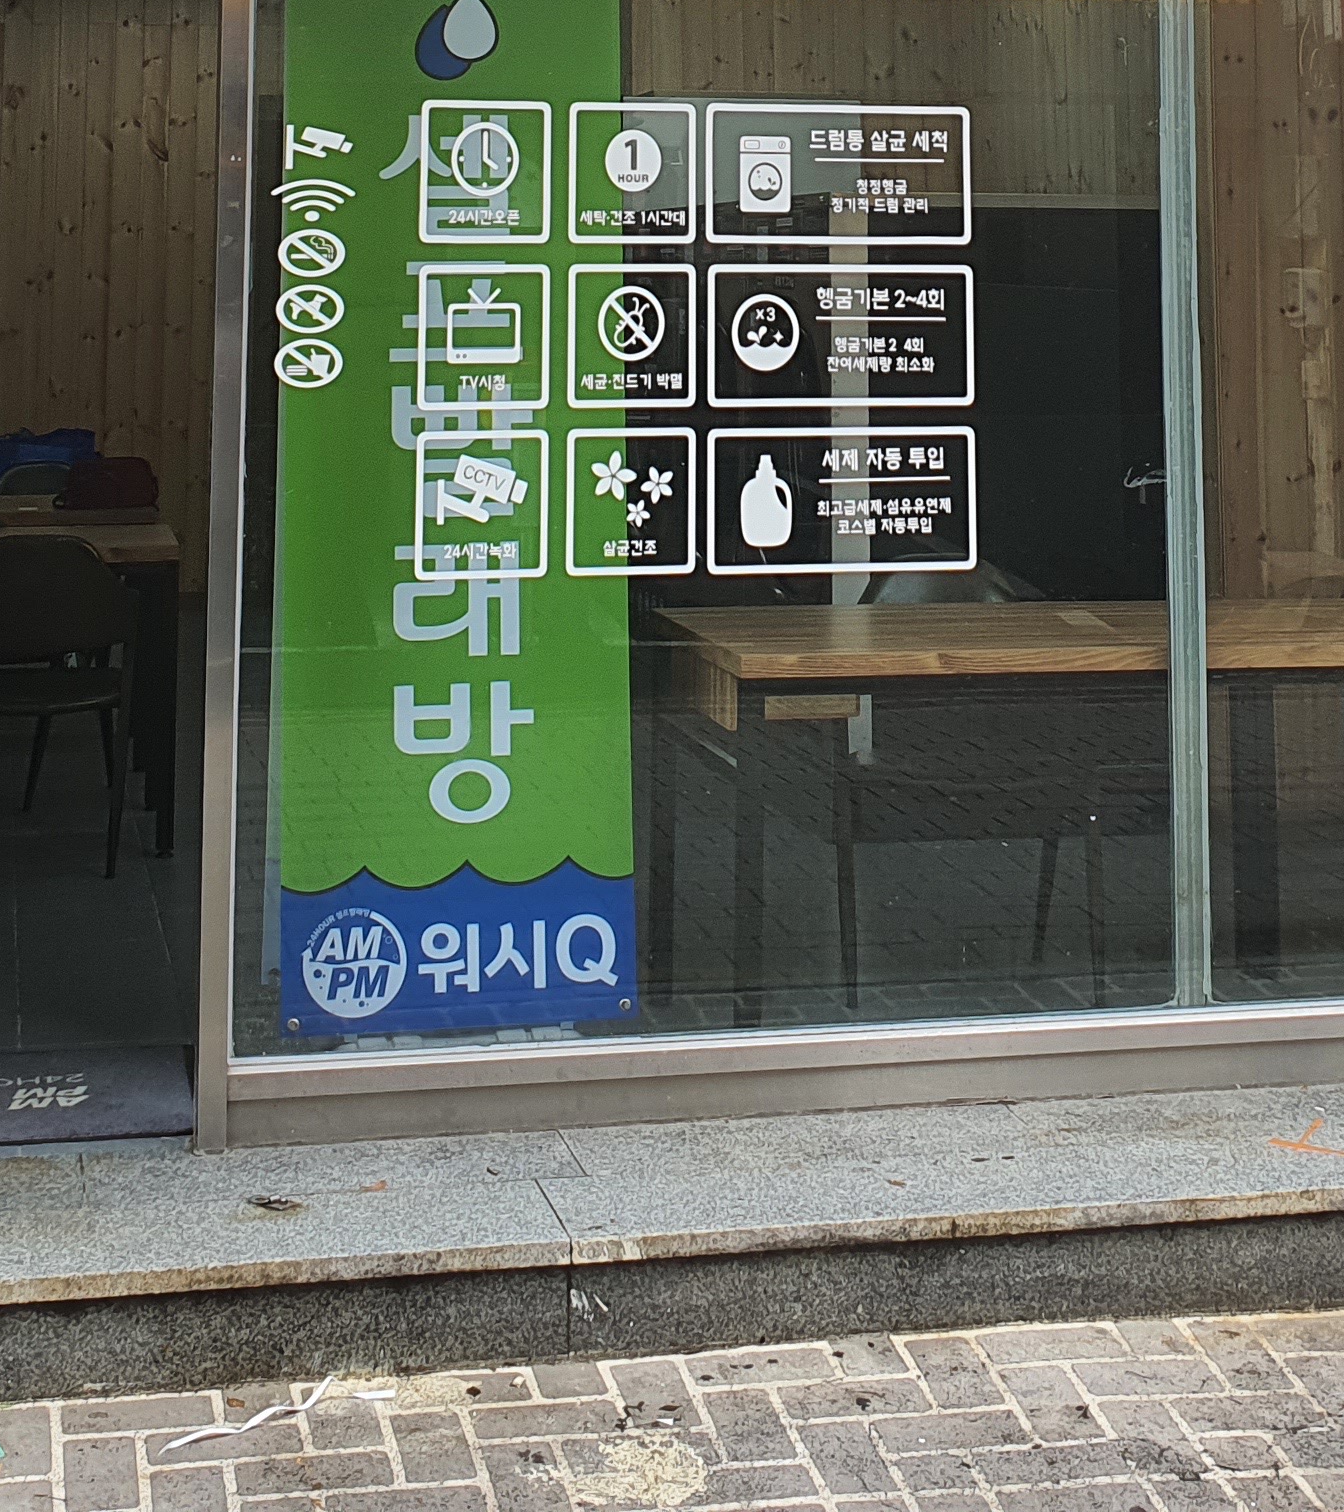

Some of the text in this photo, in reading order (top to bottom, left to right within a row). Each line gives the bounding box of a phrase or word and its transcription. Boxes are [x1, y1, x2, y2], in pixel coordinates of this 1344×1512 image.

[810, 129, 948, 153] 드럼통 살균 세척
[624, 138, 638, 170] 1
[618, 174, 649, 183] HOUR
[831, 197, 929, 213] 정기적 드럼 관리
[448, 209, 520, 226] 24시간오픈
[641, 210, 686, 226] 1시간대
[816, 287, 945, 312] 헹굼기본 2~4회
[826, 356, 935, 373] 잔여세제량 최소화
[459, 374, 506, 390] TV시청
[656, 372, 683, 390] 박멸
[822, 446, 944, 472] 세제 자동 투입
[463, 464, 506, 491] CCTV
[837, 517, 933, 535] 코스별 자동투입
[443, 542, 518, 559] 24시간녹화
[316, 926, 383, 961] AM
[418, 913, 618, 993] 워시Q
[327, 965, 390, 1000] PM
